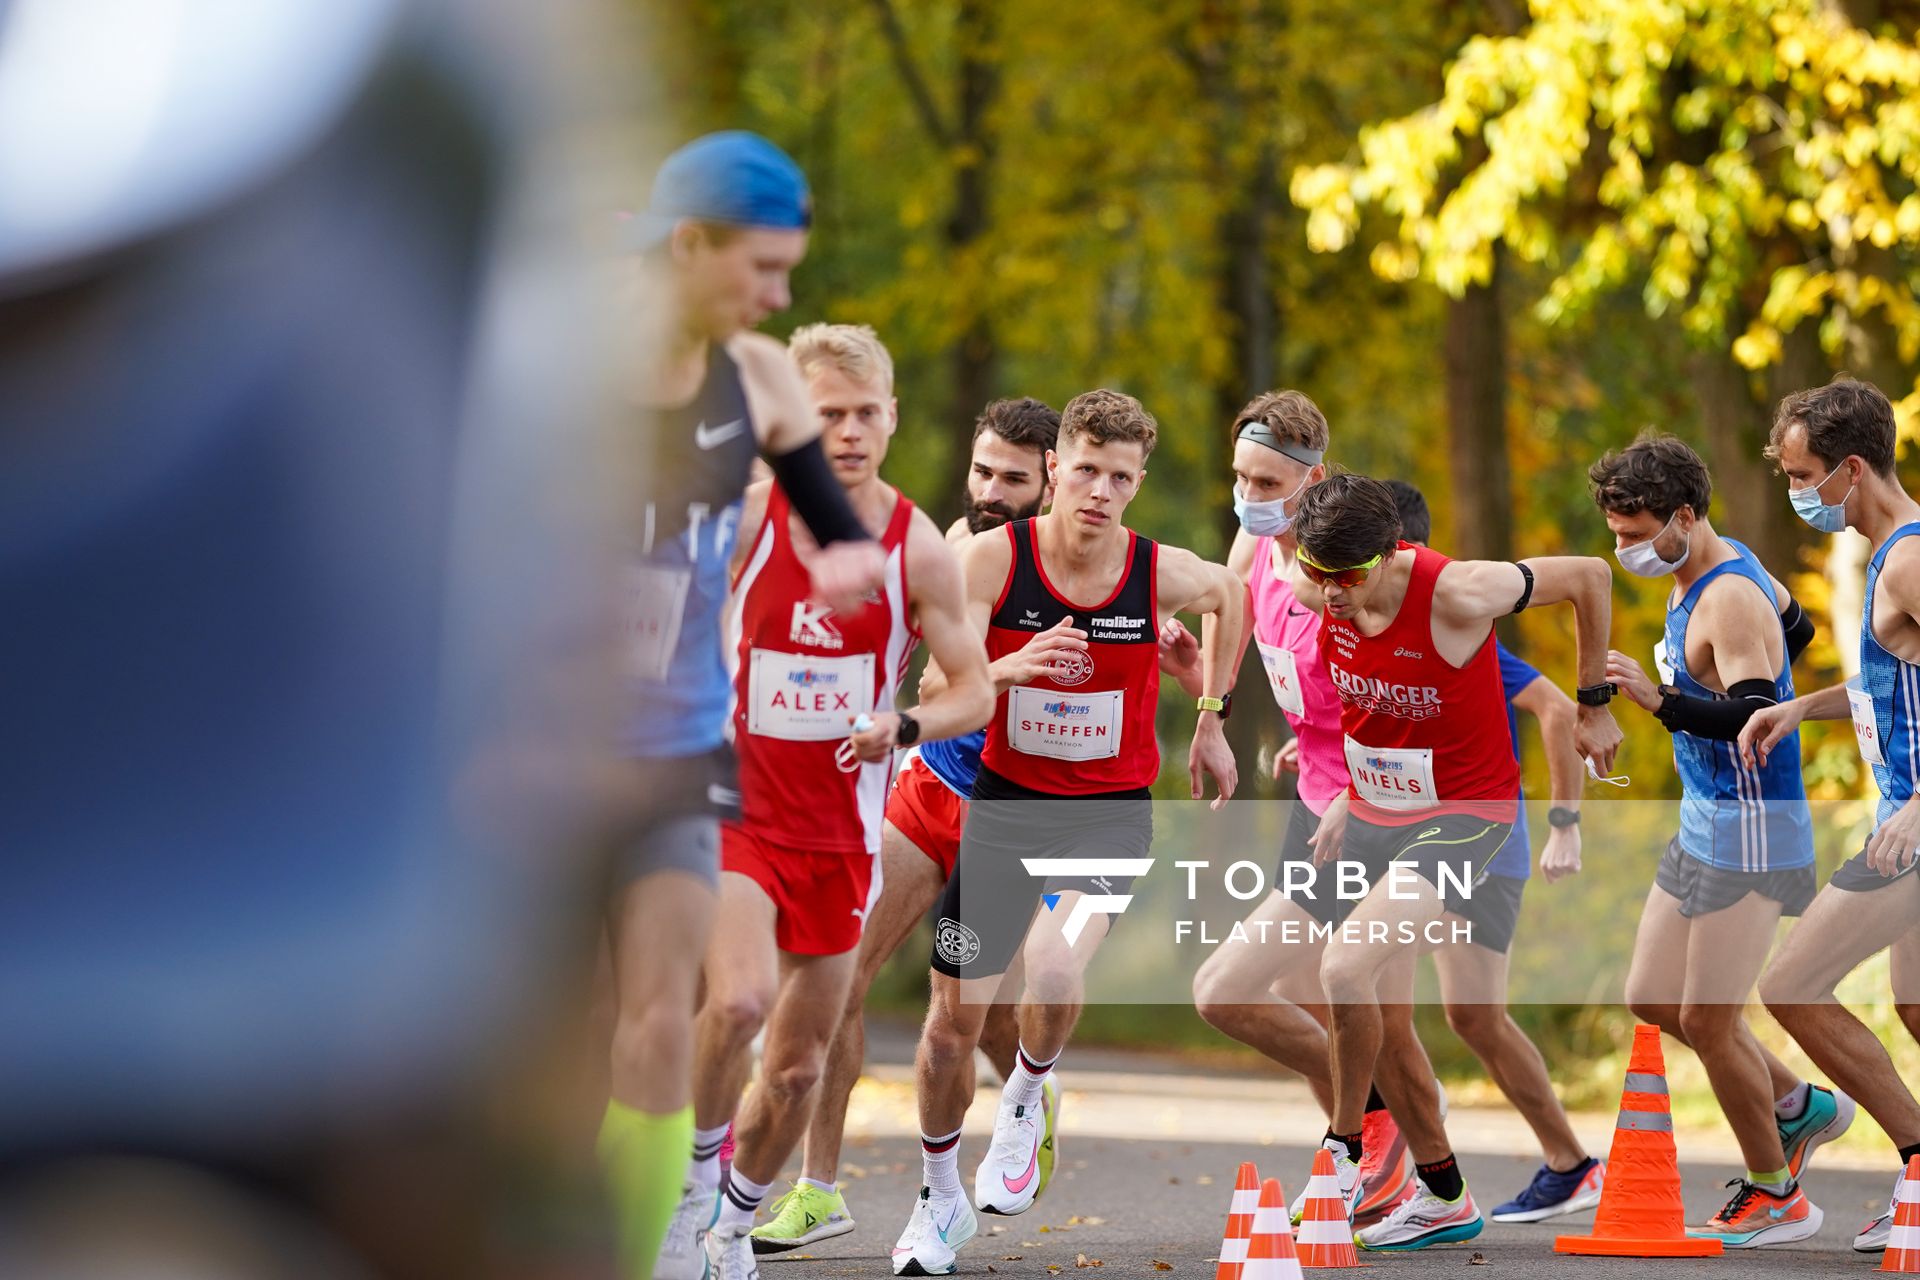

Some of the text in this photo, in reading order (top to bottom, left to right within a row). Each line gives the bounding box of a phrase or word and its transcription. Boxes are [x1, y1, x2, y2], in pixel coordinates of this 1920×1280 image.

[1019, 618, 1042, 628] erima
[790, 632, 844, 650] KIEFER
[1092, 629, 1142, 641] Laufanalyse
[1334, 634, 1356, 650] BERLIN
[1338, 625, 1360, 643] NORD
[1330, 661, 1443, 705] ERDINGER
[771, 690, 849, 711] ALEX
[1021, 720, 1106, 737] STEFFEN
[1043, 739, 1082, 748] MARATHON
[1357, 767, 1422, 794] NIELS
